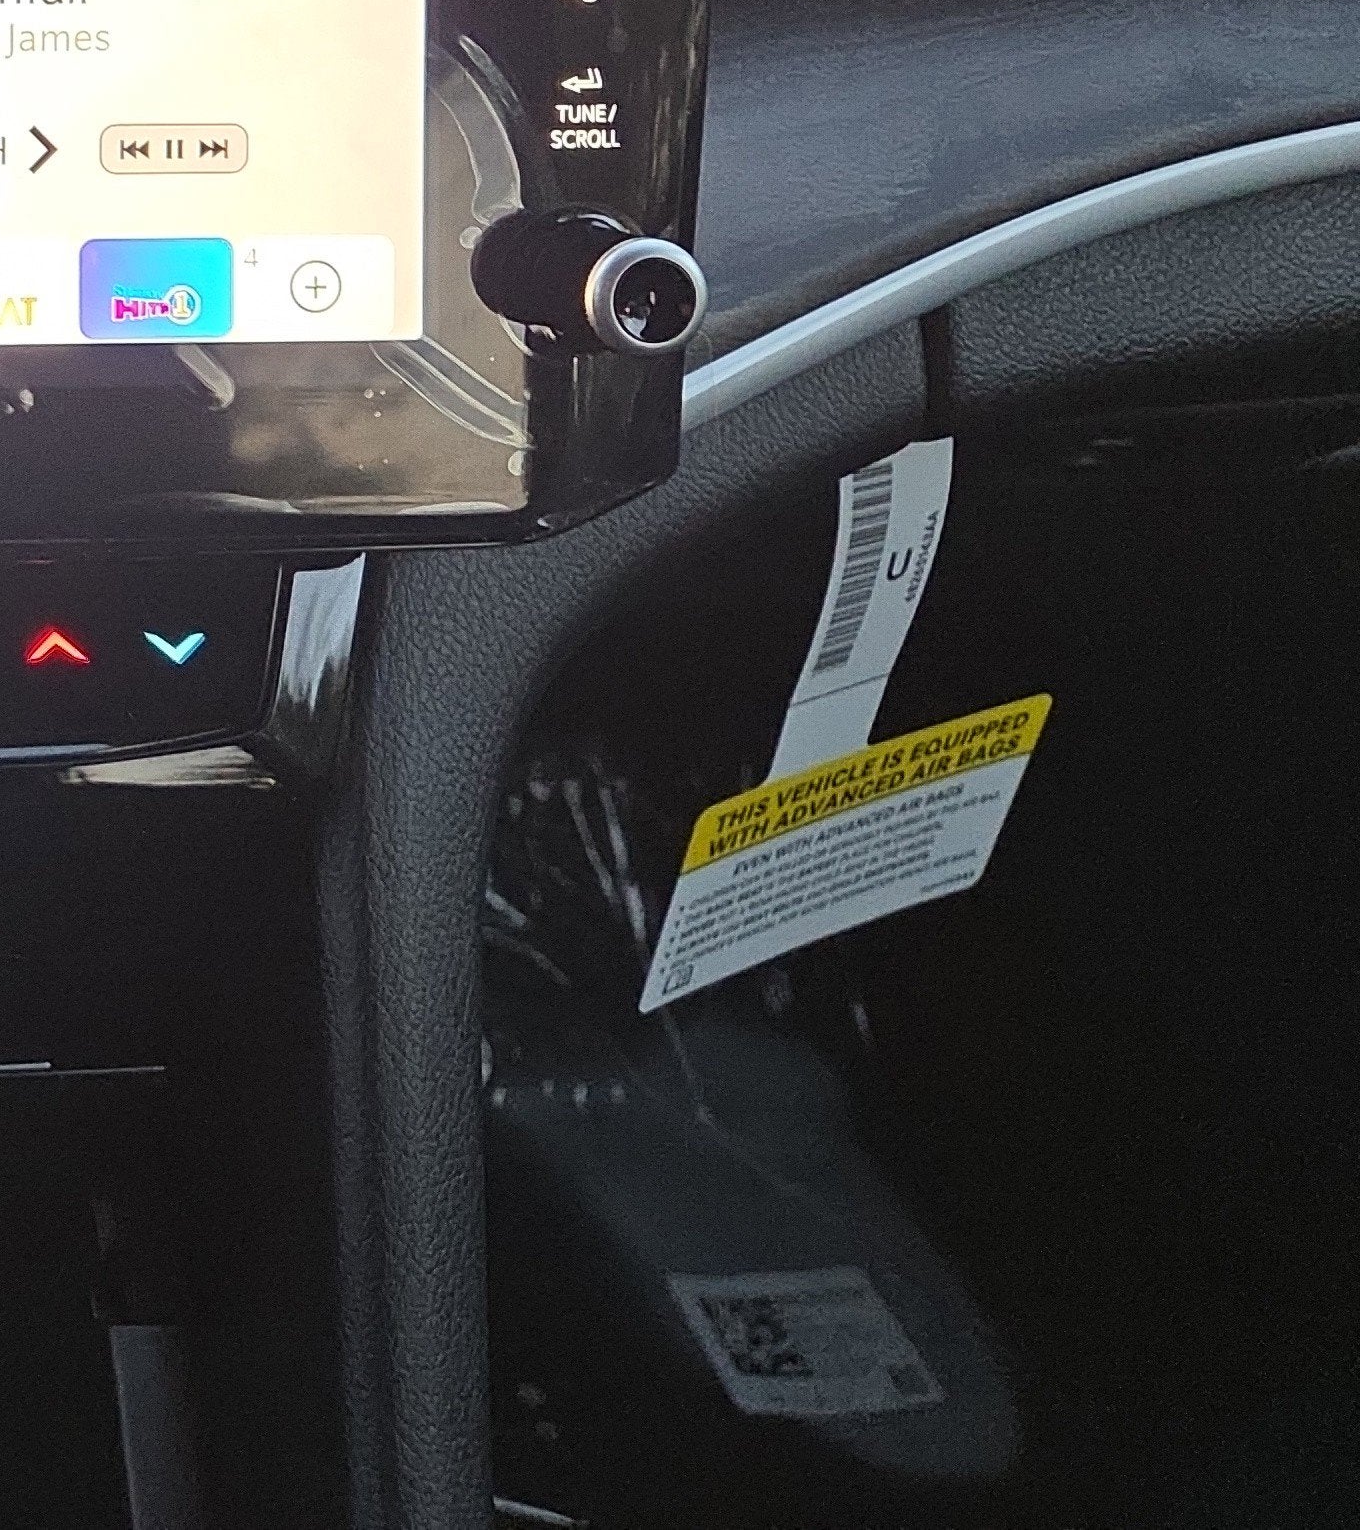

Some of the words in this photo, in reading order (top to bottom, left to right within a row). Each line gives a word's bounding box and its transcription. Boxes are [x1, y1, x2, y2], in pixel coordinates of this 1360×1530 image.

[2, 24, 111, 59] James
[554, 104, 618, 125] TUNE/
[549, 129, 621, 150] SCROLL
[243, 248, 260, 268] 4
[886, 547, 913, 581] U
[714, 799, 770, 833] THIS
[774, 762, 879, 810] VEHICLE
[879, 747, 907, 771] IS
[909, 710, 1031, 764] EQUIPPED
[706, 828, 770, 859] WITH
[773, 771, 908, 829] ADVANCED
[909, 755, 954, 784] AIR
[955, 733, 1022, 771] BAGS
[813, 804, 895, 845] ADVANCED
[896, 794, 923, 815] AIR
